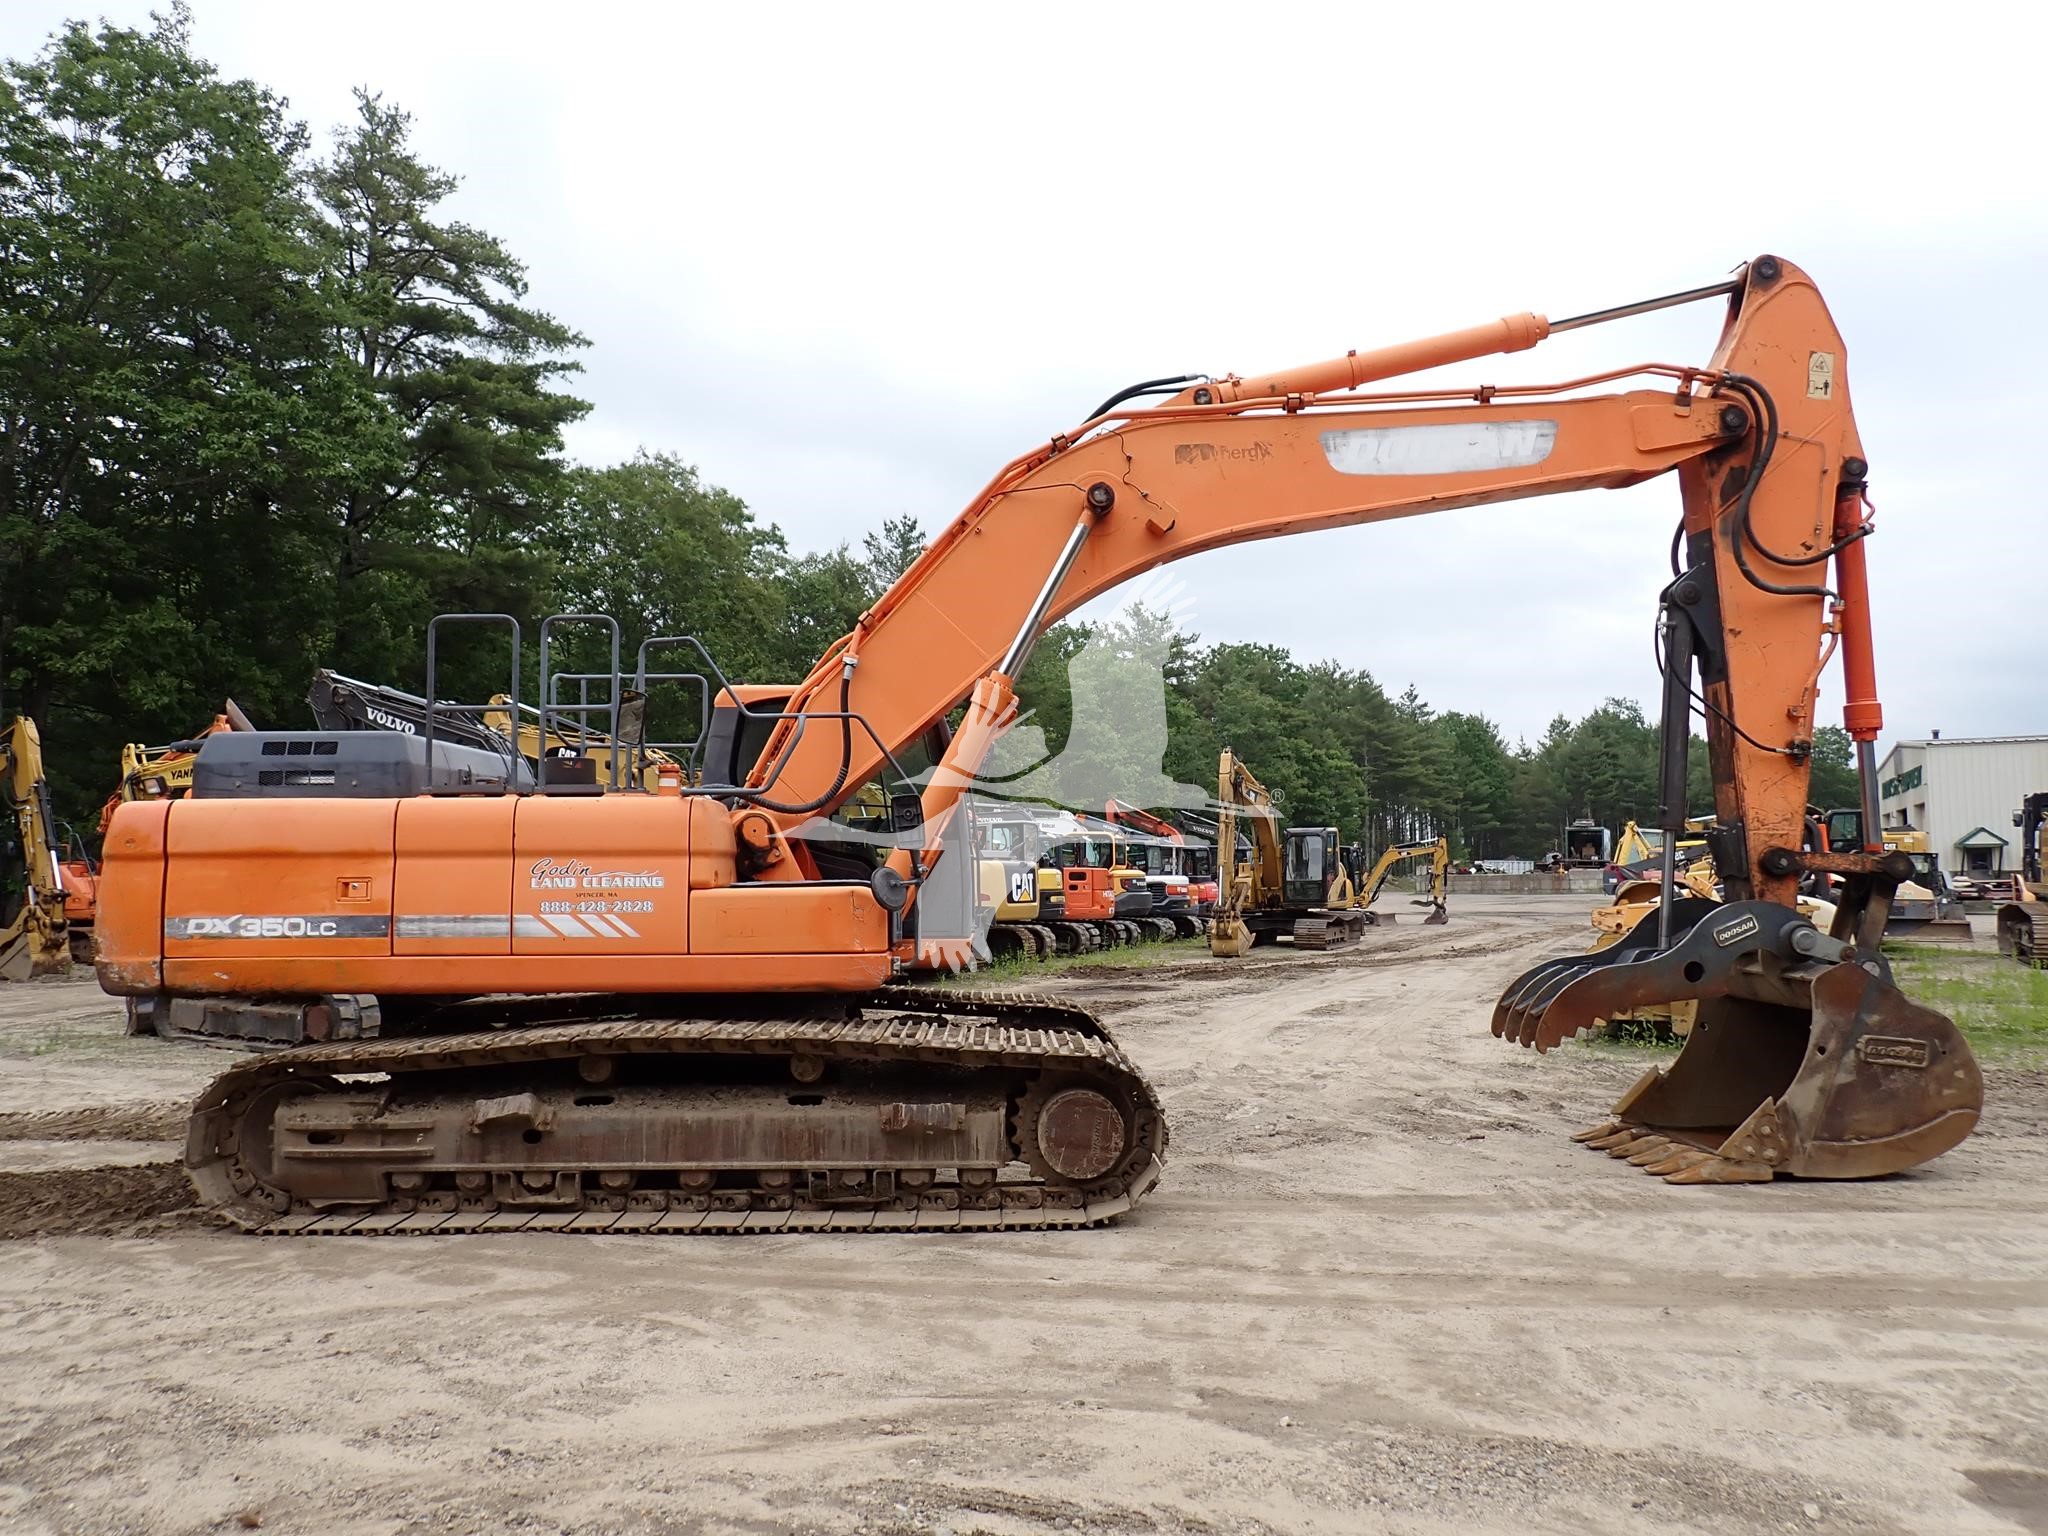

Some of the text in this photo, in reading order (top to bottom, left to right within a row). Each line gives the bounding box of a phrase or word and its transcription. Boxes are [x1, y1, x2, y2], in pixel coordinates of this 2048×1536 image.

[366, 706, 416, 735] VOLVO
[558, 747, 577, 758] CAT
[1192, 825, 1215, 835] VOLVO
[530, 858, 591, 880] Godin
[530, 876, 665, 889] LAND CLEARING
[1011, 872, 1034, 902] CAT
[540, 900, 654, 914] 888-428-2828
[186, 914, 244, 935] DX
[1719, 920, 1755, 941] DOOSAN
